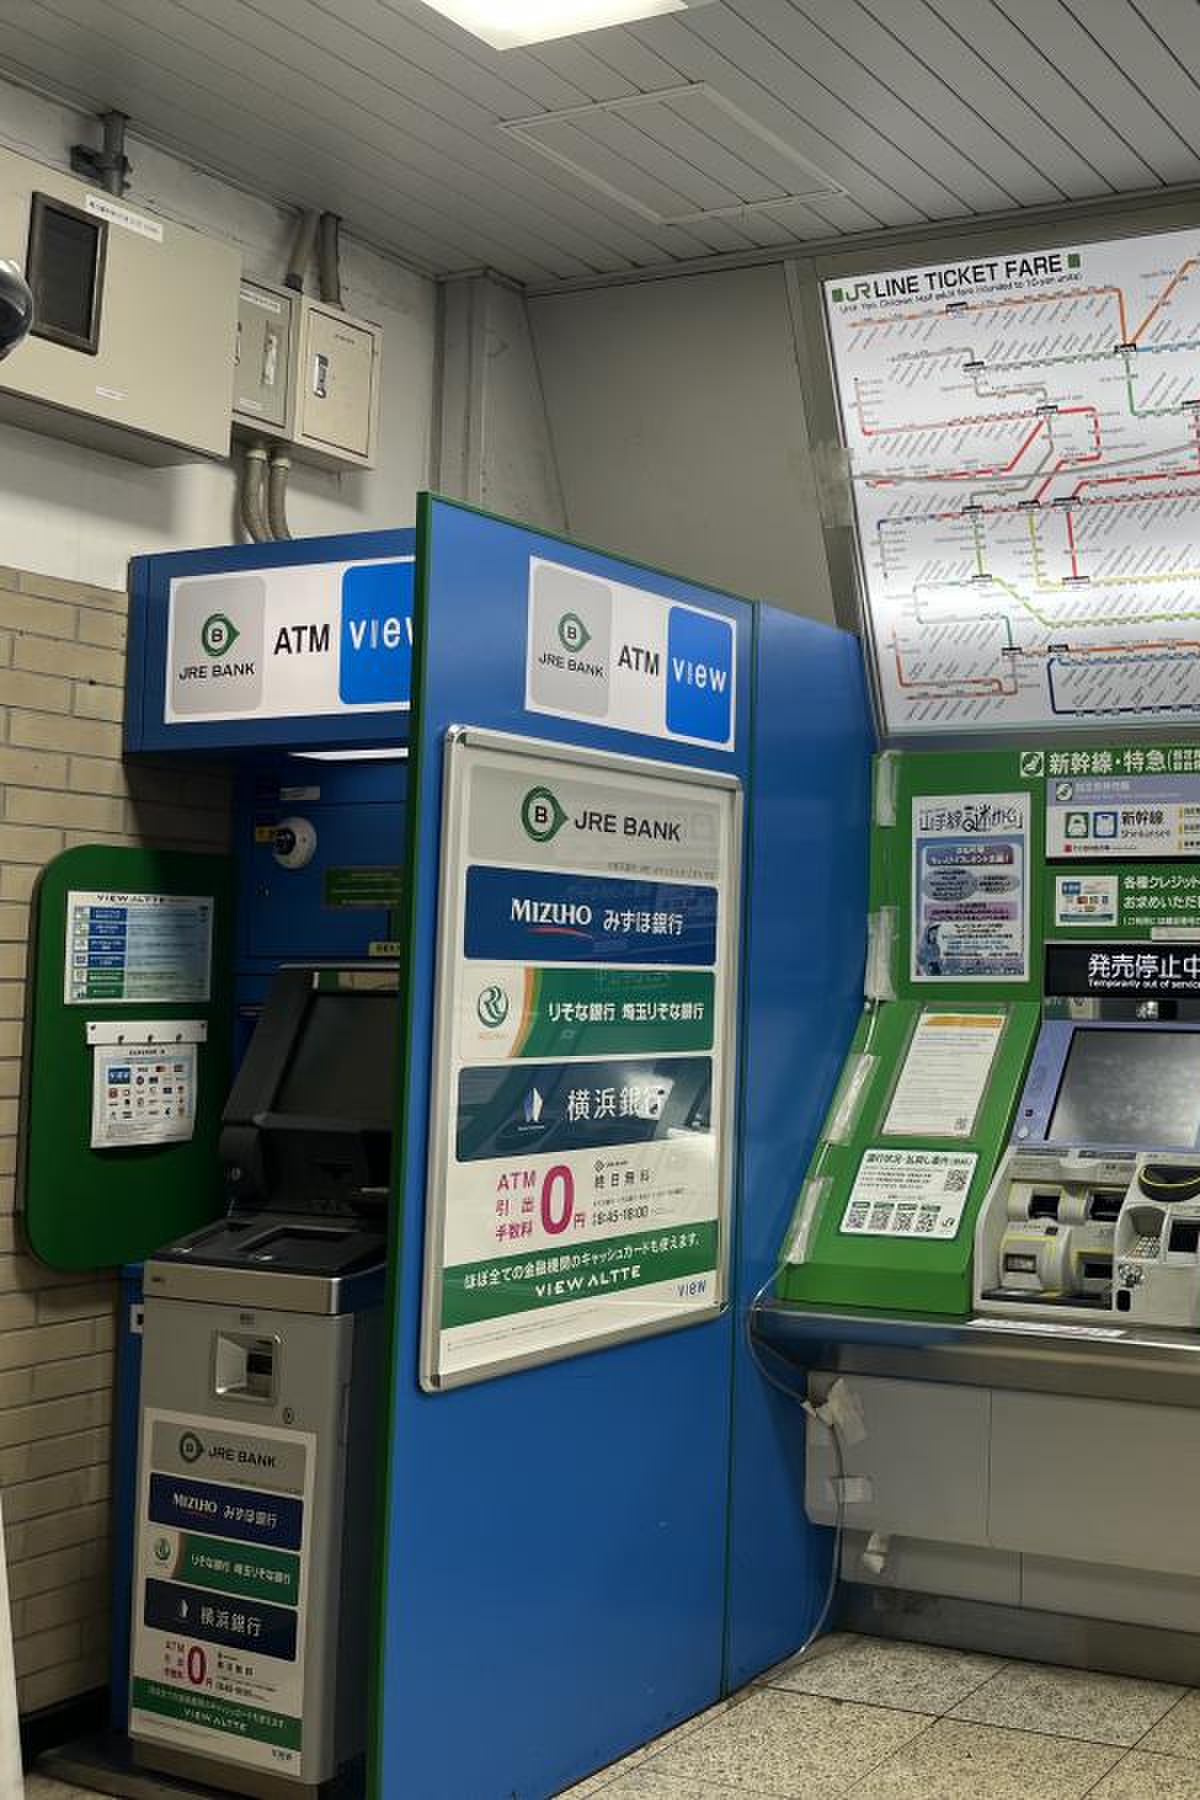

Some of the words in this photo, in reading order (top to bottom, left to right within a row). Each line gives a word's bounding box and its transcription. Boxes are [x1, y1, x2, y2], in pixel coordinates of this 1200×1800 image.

[846, 282, 873, 301] JR
[873, 274, 920, 298] LINE
[924, 263, 998, 291] TICKET
[1005, 253, 1062, 279] FARE
[274, 623, 330, 656] ATM
[179, 663, 208, 681] JRE
[211, 660, 255, 680] BANK
[538, 651, 564, 671] JRE
[566, 656, 603, 678] BANK
[617, 644, 659, 678] ATM
[575, 810, 617, 834] JRE
[622, 816, 681, 842] BANK
[1120, 810, 1164, 827] 新幹線
[511, 897, 593, 926] MIZUHO
[603, 909, 684, 936] みずほ銀行
[1088, 978, 1140, 989] Temporarily
[1142, 979, 1159, 988] out
[1160, 978, 1170, 988] of
[549, 1002, 616, 1023] りそな銀行
[622, 1001, 705, 1023] 埼玉りそな銀行
[497, 1169, 537, 1192] ATM
[540, 1164, 575, 1235] 0
[208, 1446, 235, 1462] JRE
[237, 1450, 277, 1469] BANK
[173, 1491, 218, 1514] MIZUHO
